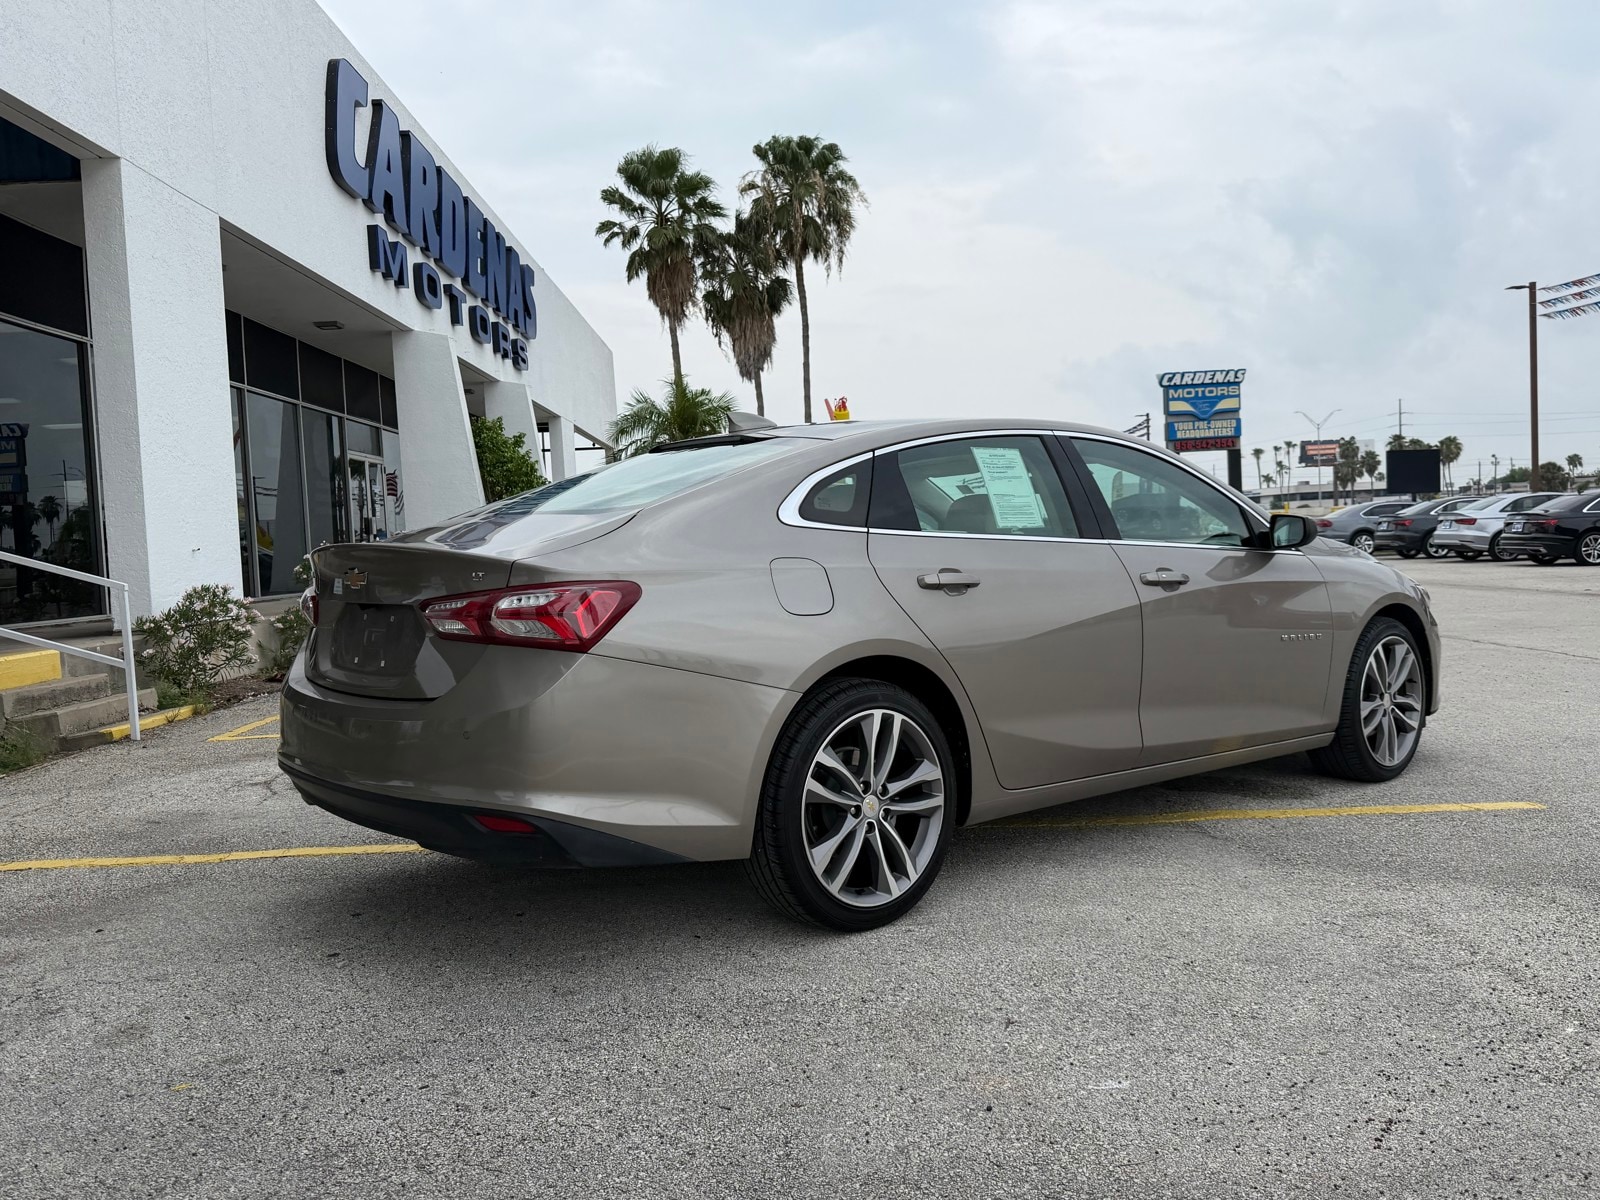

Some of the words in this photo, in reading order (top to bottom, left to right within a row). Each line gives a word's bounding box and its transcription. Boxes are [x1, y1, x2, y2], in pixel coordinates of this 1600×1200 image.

[325, 58, 537, 340] CARDENAS
[367, 224, 528, 371] MOTORS
[1160, 369, 1246, 387] CARDENAS
[1168, 386, 1240, 398] MOTORS
[1174, 422, 1193, 431] YOUR
[1194, 419, 1237, 430] PRE-OWNED
[1176, 427, 1235, 439] HEADQUARTERS!
